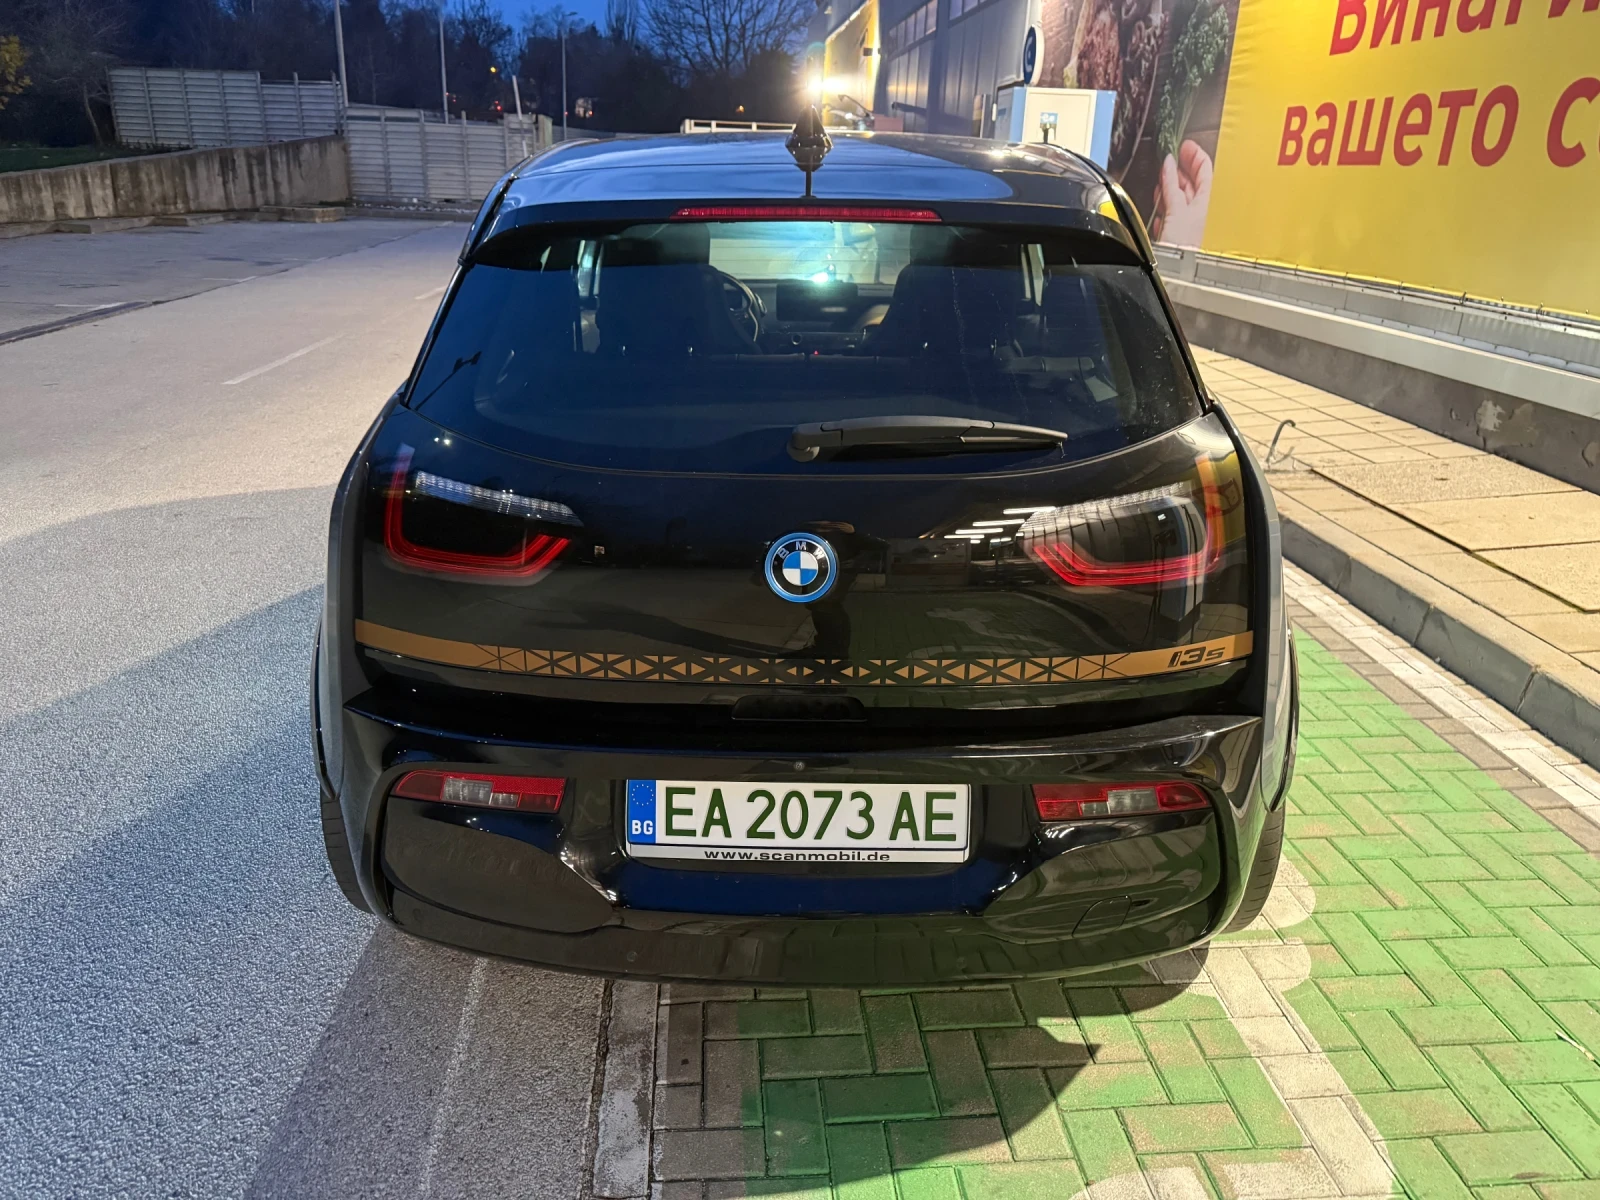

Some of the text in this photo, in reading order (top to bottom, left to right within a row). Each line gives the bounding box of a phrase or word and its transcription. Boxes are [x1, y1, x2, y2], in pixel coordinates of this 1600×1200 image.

[1277, 84, 1520, 167] вашето
[776, 540, 826, 560] BMW
[665, 786, 957, 842] EA 2073 AE
[631, 819, 654, 835] BG
[704, 850, 890, 861] www.scanmobil.de
